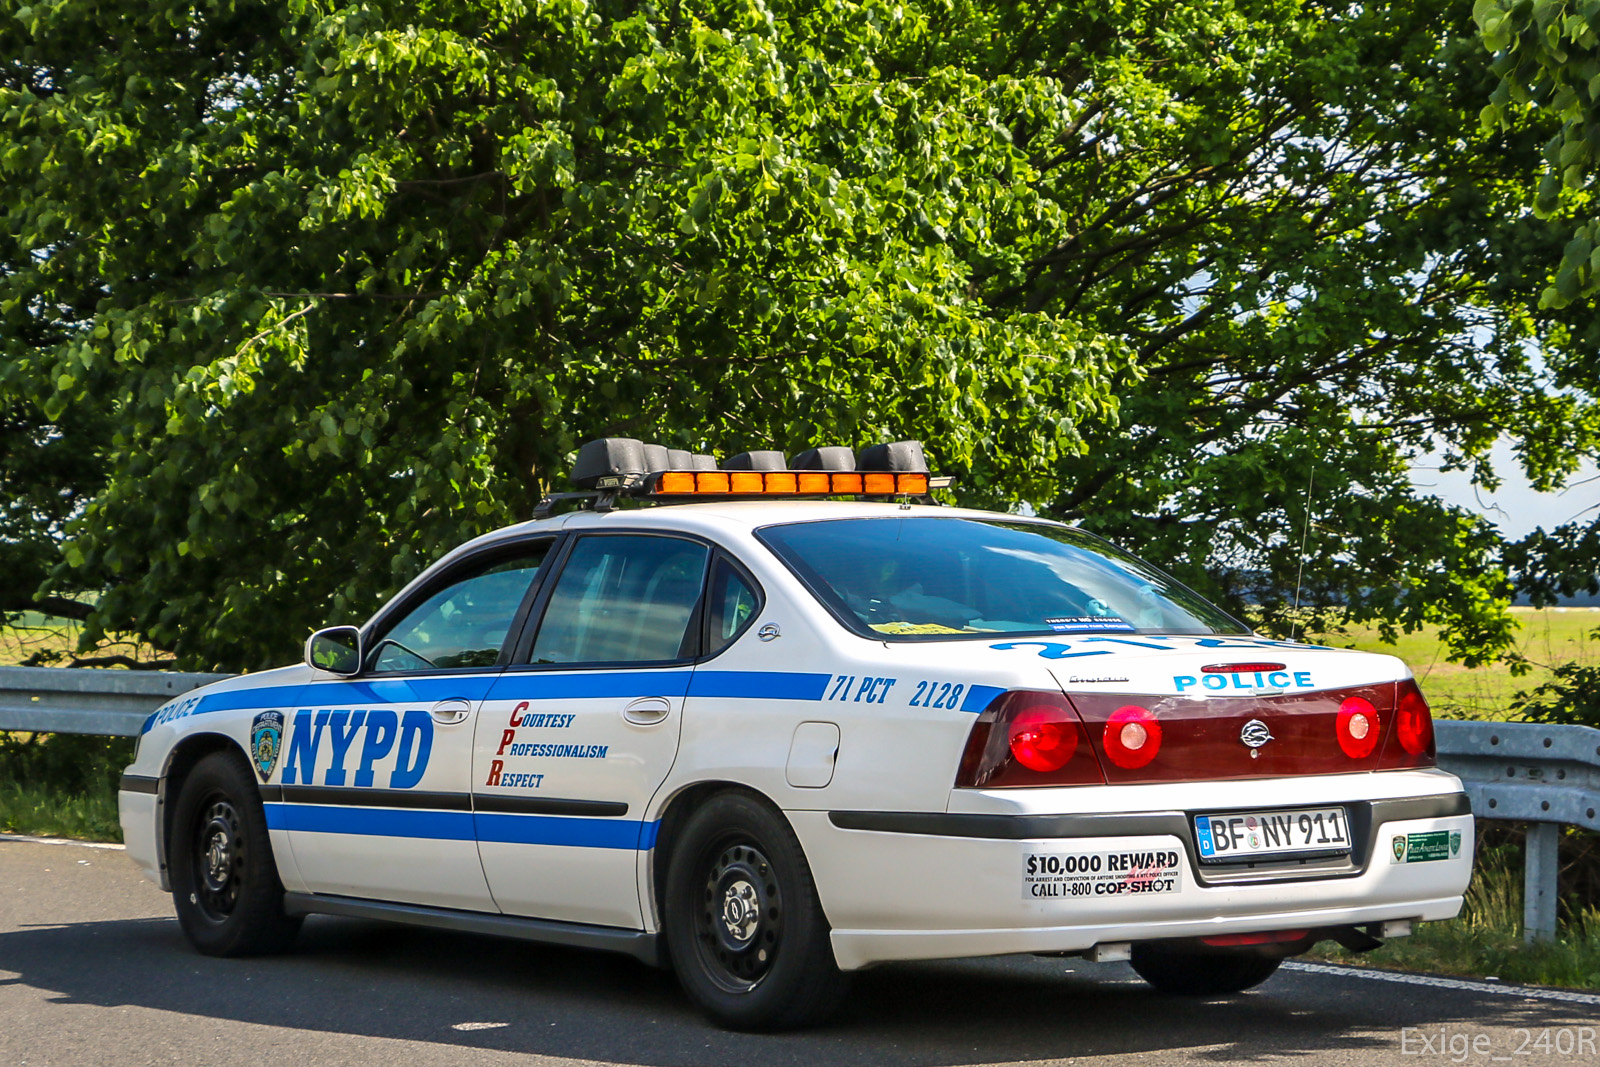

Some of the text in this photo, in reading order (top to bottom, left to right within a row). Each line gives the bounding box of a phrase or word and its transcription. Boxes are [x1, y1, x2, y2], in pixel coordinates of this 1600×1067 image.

[828, 675, 964, 710] 71 PCT 2128
[1173, 671, 1315, 692] POLICE
[153, 697, 199, 728] POLICE
[260, 712, 279, 721] POLICE
[509, 701, 576, 728] COURTESY
[252, 719, 283, 735] DEPARTMENT
[280, 709, 434, 789] NYPD
[496, 729, 609, 759] PROFESSIONALISM
[485, 759, 545, 788] RESPECT
[1202, 839, 1211, 850] D
[1211, 812, 1345, 851] BF NY 911
[1027, 851, 1179, 876] $10,000 REWARD
[1115, 872, 1136, 880] SHOOTING
[1031, 883, 1059, 897] CALL
[1062, 882, 1092, 897] 1-800
